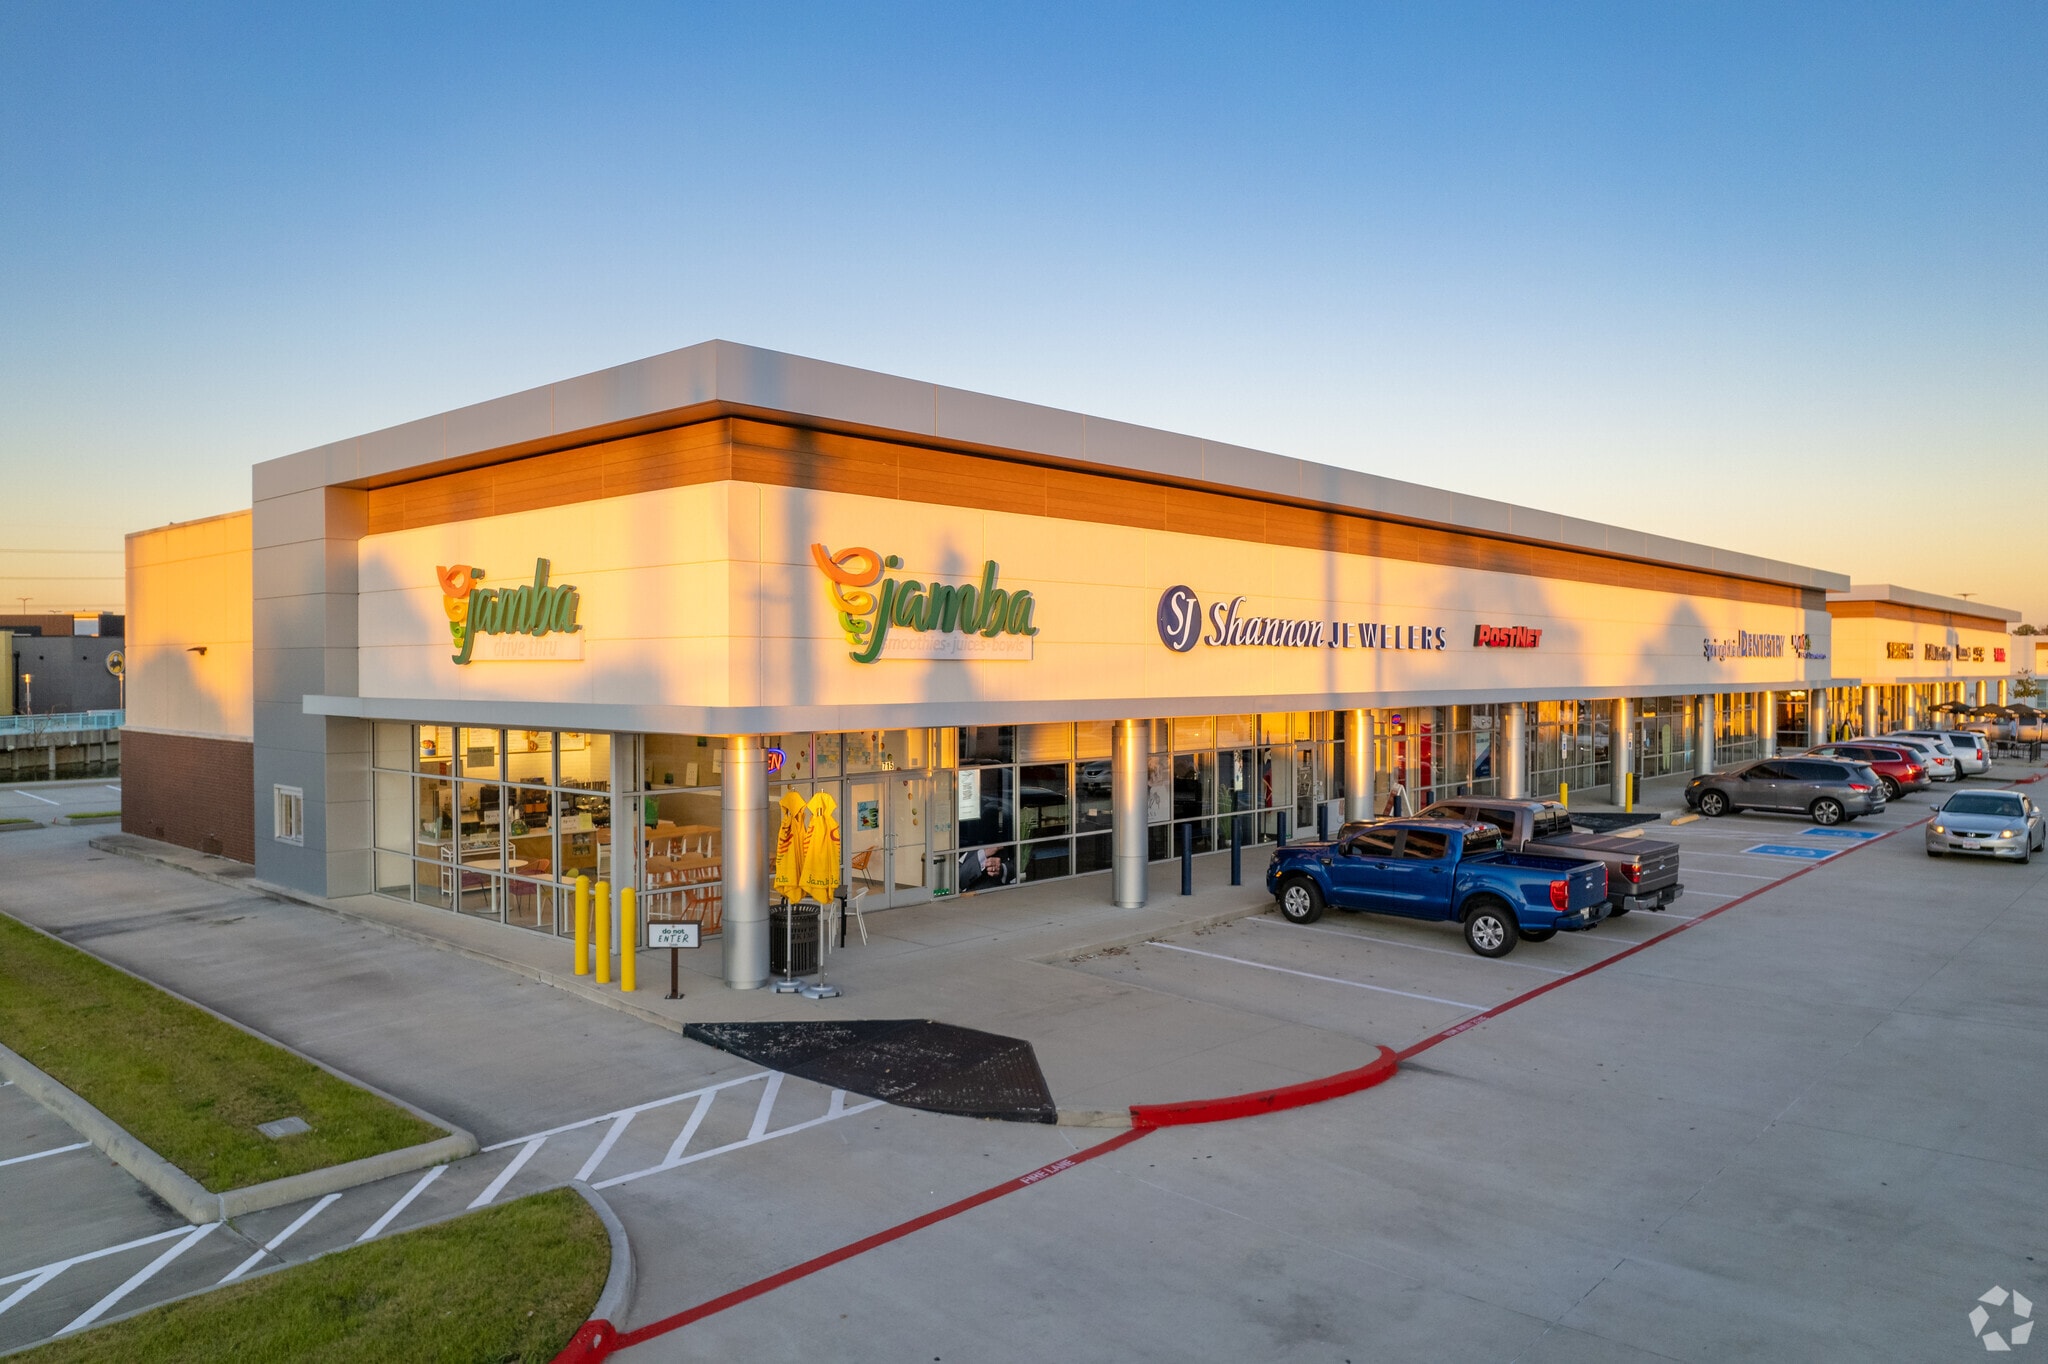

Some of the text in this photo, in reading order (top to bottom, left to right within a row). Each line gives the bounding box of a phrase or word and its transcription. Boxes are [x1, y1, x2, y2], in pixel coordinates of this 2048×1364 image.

[451, 557, 583, 665] jamba
[849, 554, 1037, 664] jamba
[1166, 591, 1197, 650] SJ
[1204, 596, 1447, 650] Shannon JEWELERS
[658, 934, 689, 943] ENTER
[1020, 1159, 1076, 1185] FIRE LANE
